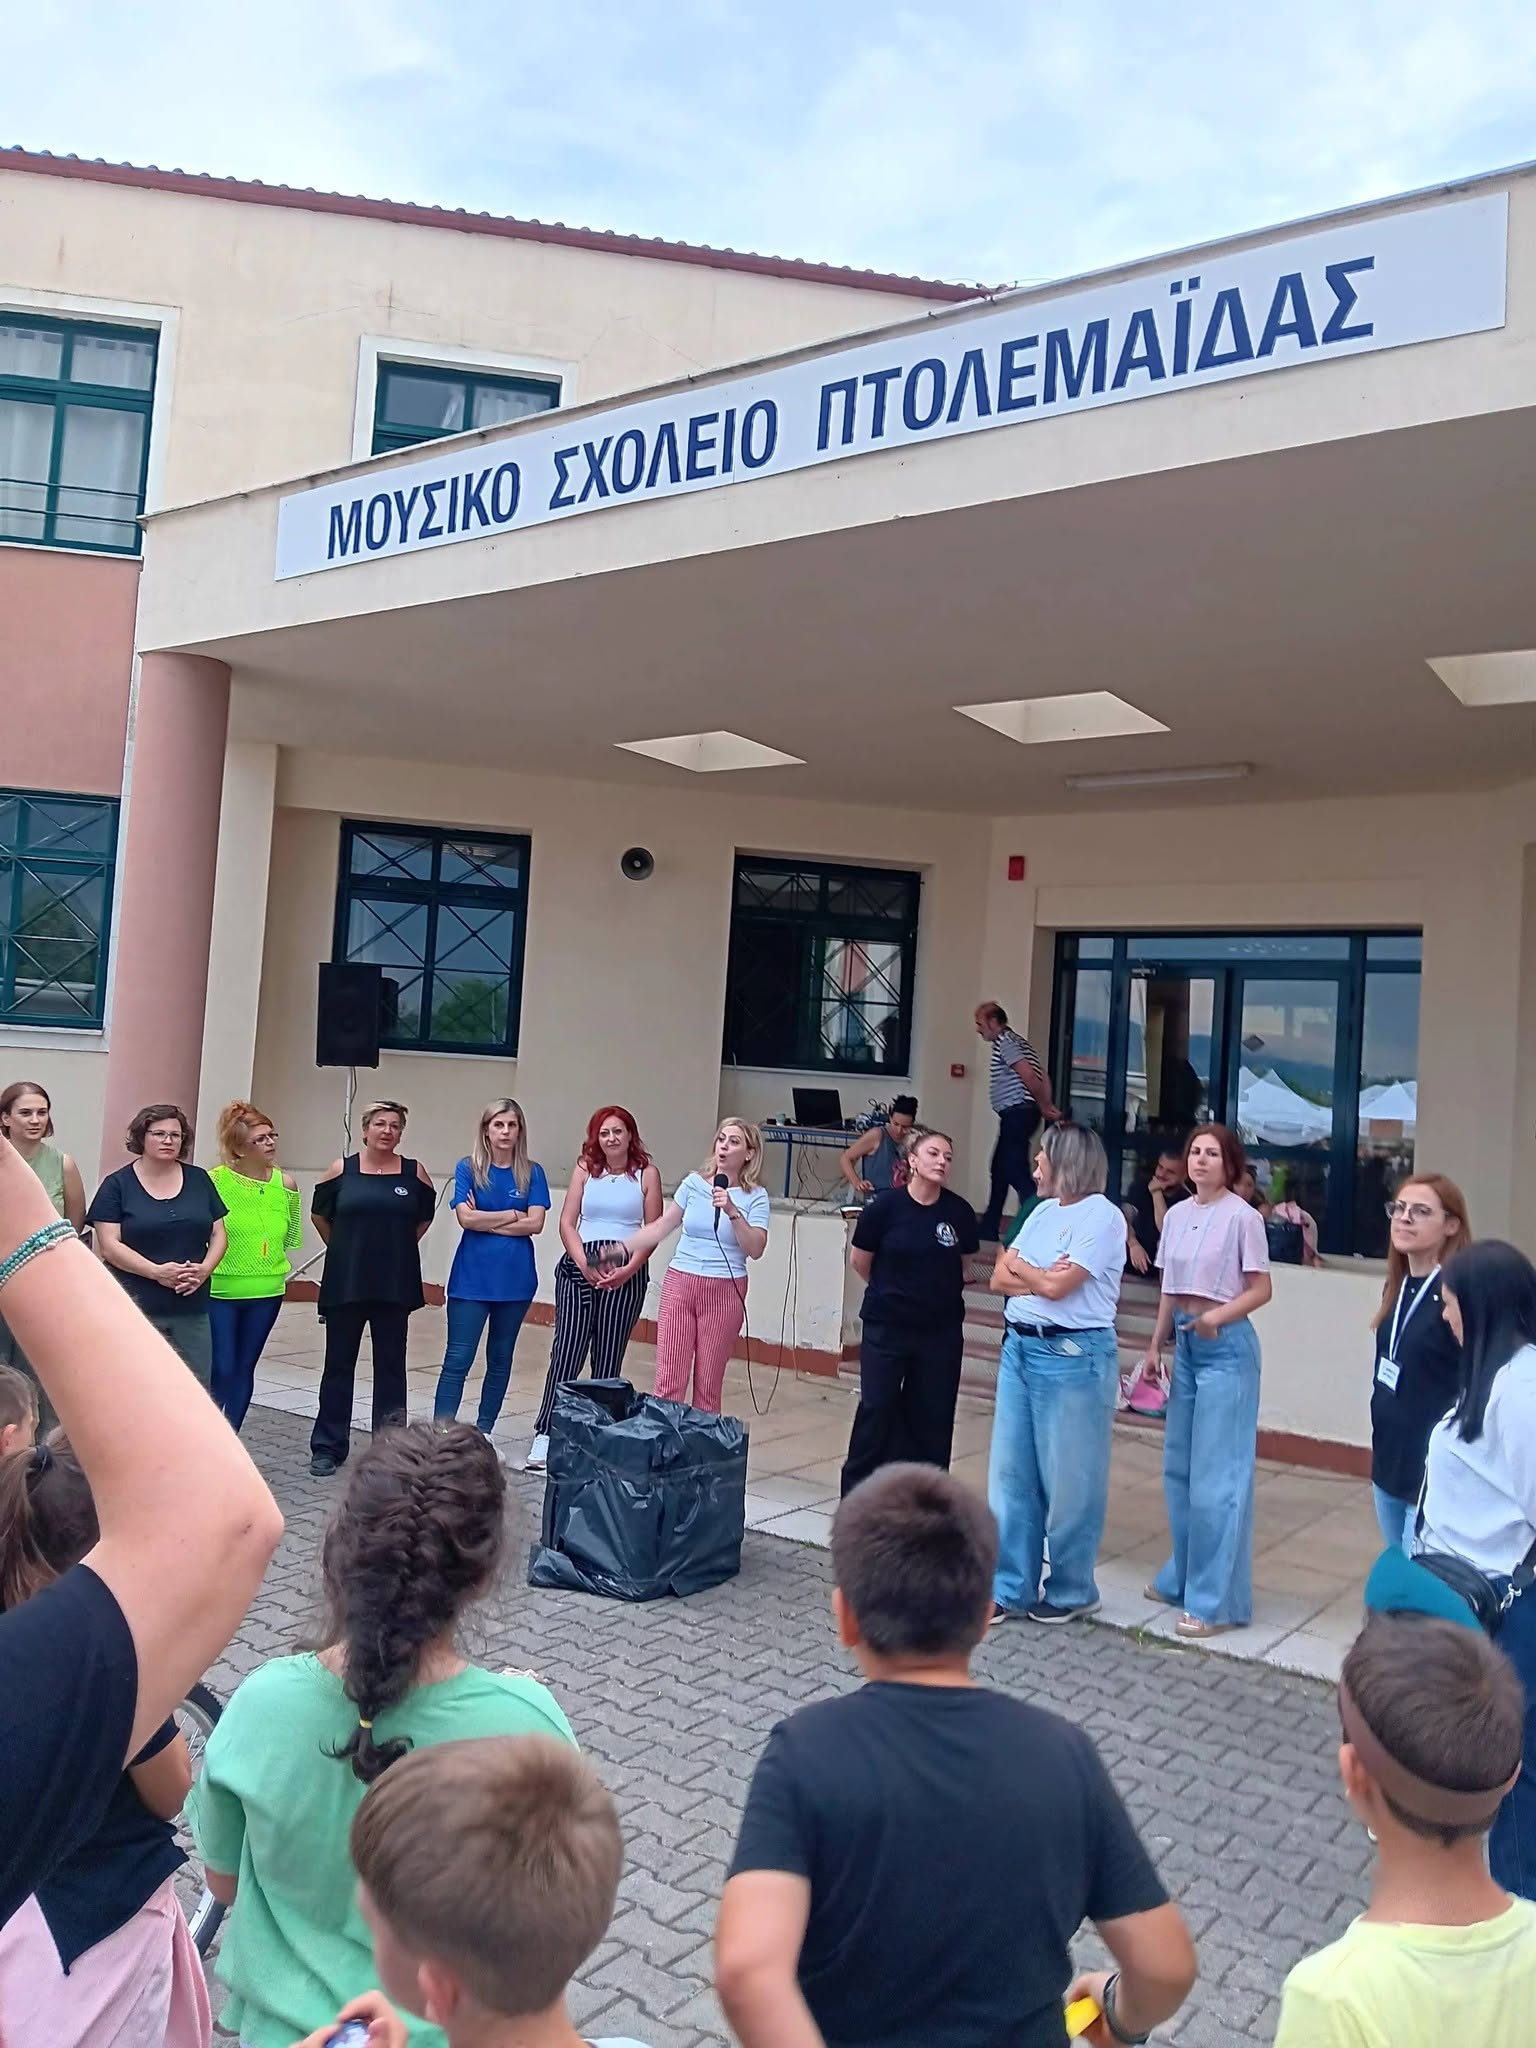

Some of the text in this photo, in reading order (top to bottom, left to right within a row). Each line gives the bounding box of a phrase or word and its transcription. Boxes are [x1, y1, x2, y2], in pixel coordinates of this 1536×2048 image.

[328, 255, 1375, 560] ΜΟΥΣΙΚΟ ΣΧΟΛΕΙΟ ΠΤΟΛΕΜΑΪΔΑΣ
